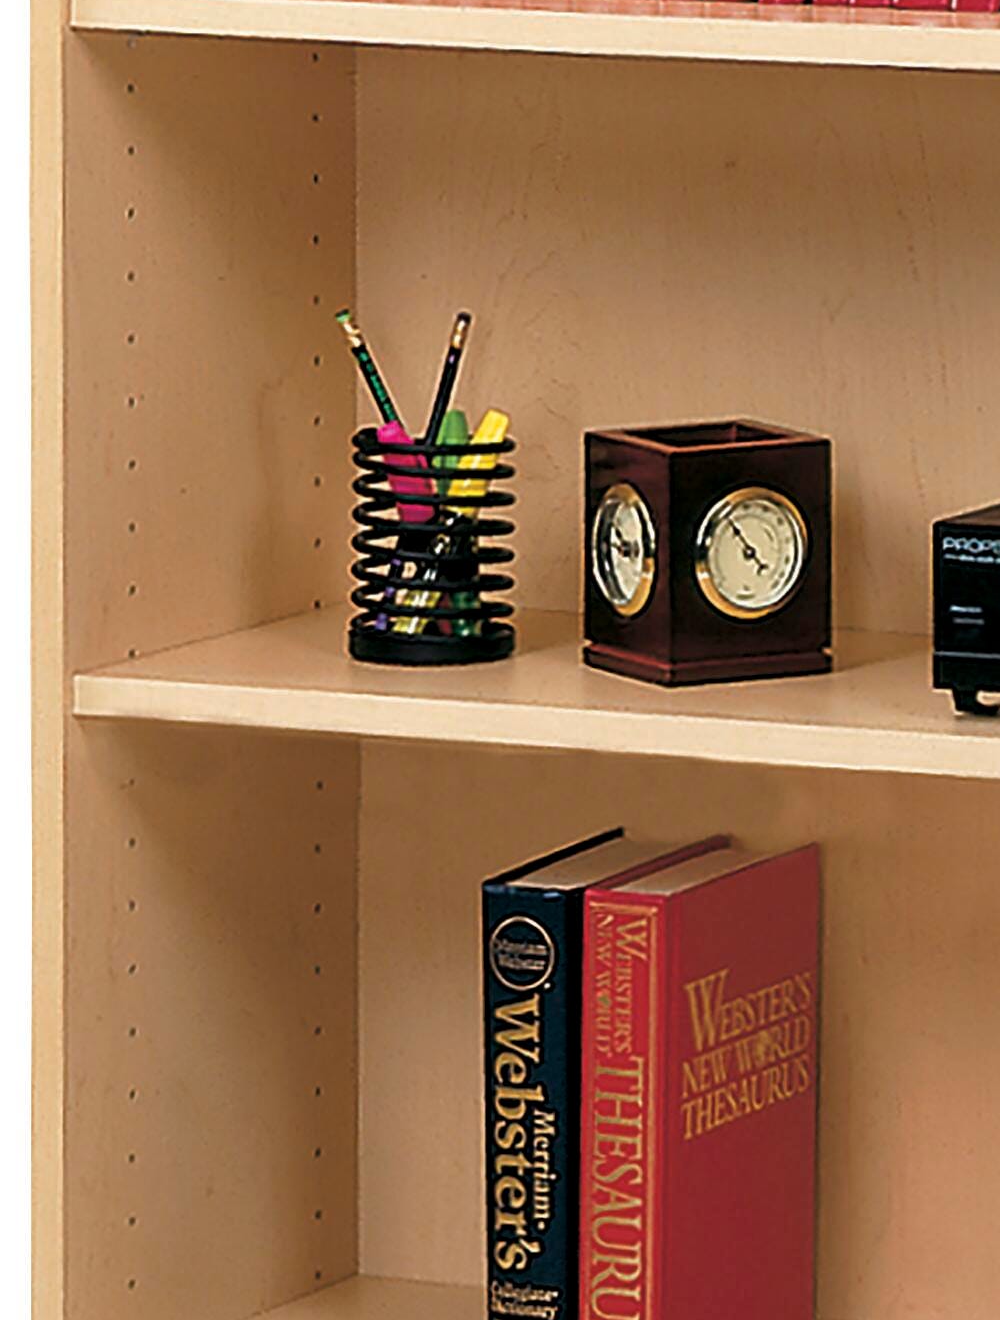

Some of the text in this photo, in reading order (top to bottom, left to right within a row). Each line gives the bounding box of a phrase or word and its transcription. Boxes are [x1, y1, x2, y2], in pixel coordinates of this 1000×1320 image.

[614, 918, 648, 1056] WEBSTER'S
[684, 969, 811, 1052] WEBSTER'S
[681, 1015, 811, 1099] NEW WORLD
[681, 1053, 811, 1140] THESAURUS
[494, 992, 546, 1270] Webster's
[532, 1109, 557, 1230] Merriam-
